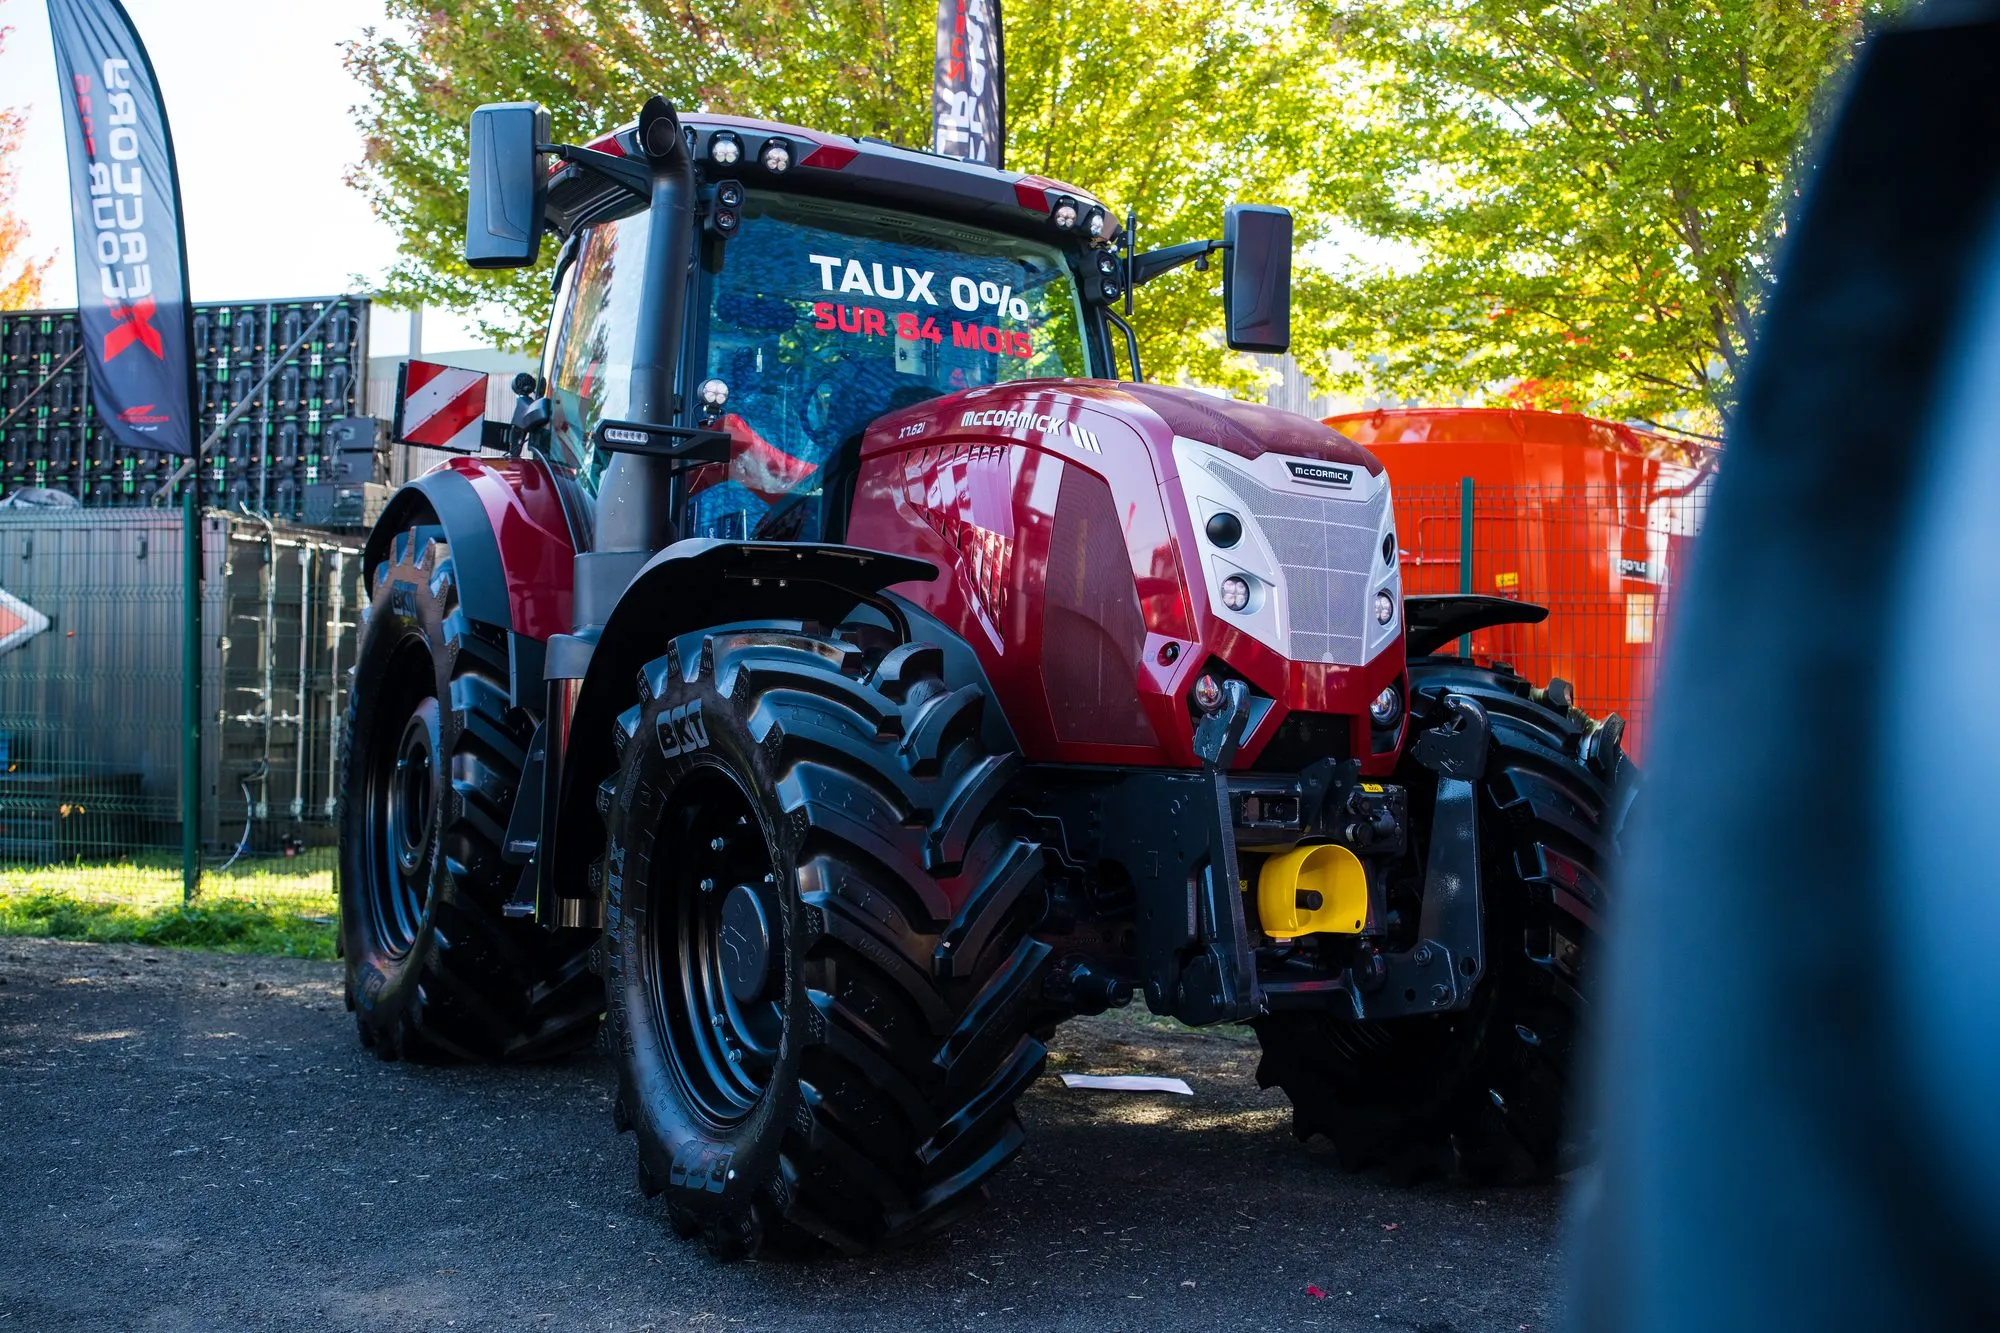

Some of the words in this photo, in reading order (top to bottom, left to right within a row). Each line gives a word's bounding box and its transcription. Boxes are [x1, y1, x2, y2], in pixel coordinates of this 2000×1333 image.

[809, 254, 939, 306] TAUX
[950, 276, 1029, 321] 0%
[814, 302, 887, 337] SUR
[897, 312, 943, 345] 84
[952, 320, 1033, 359] MOIS
[656, 702, 708, 756] BKT
